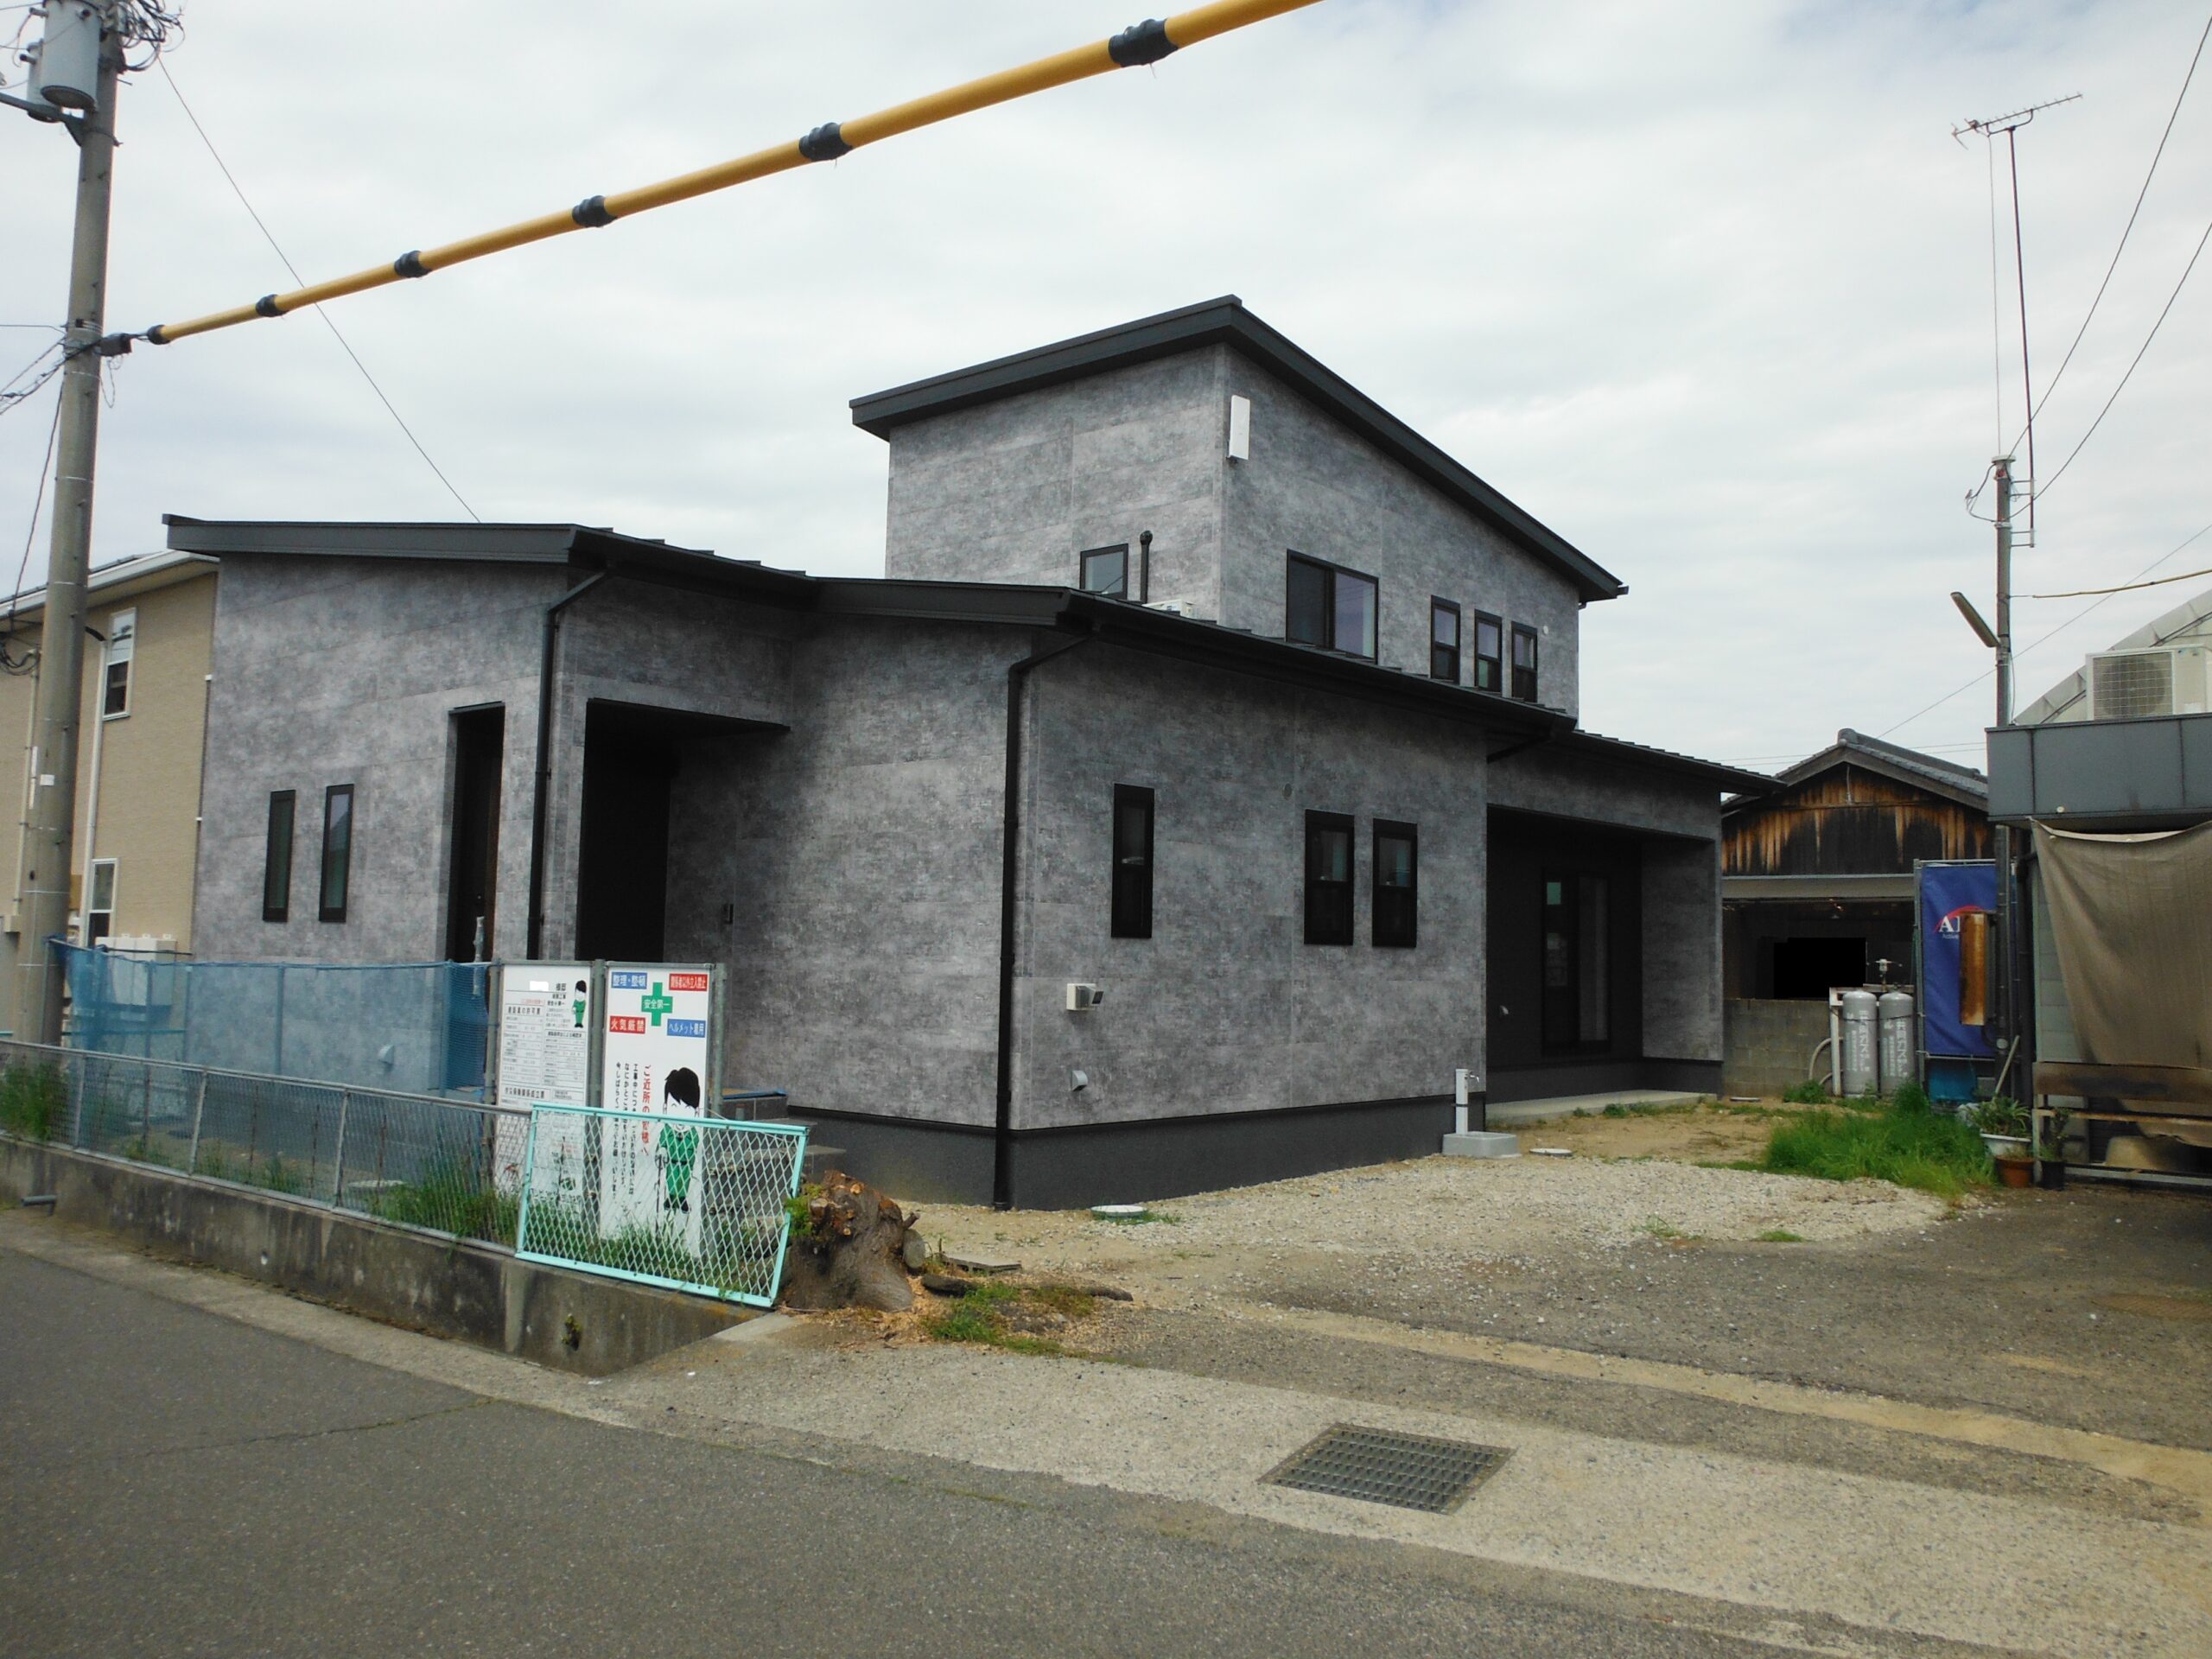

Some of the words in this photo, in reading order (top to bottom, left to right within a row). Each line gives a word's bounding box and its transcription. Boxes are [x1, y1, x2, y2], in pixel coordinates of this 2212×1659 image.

[613, 975, 645, 987] 整理・整頓
[670, 976, 706, 989] 関係者以外立入禁止
[644, 999, 671, 1009] 安全第一
[610, 1019, 645, 1032] 火気厳禁
[669, 1023, 704, 1035] ヘルメット着用
